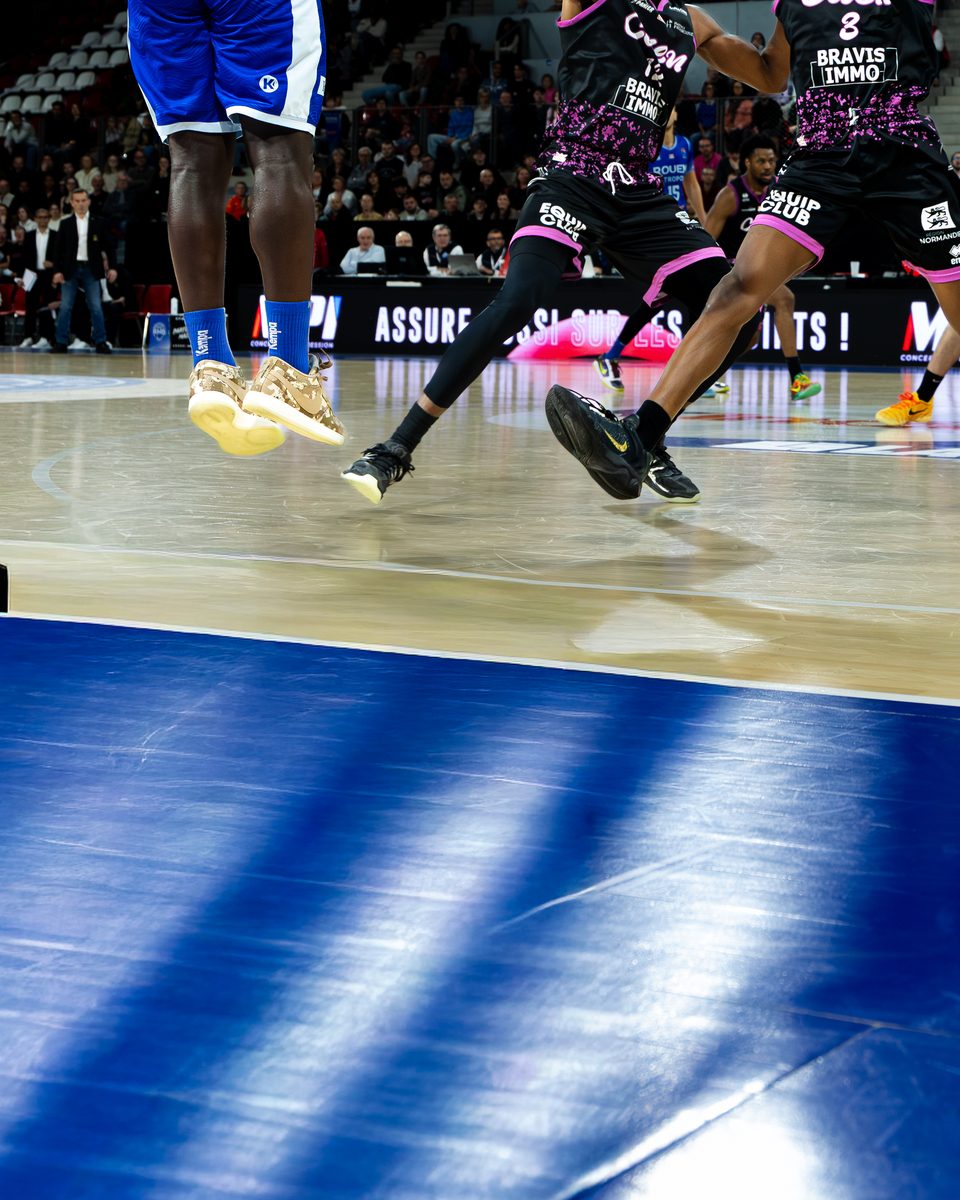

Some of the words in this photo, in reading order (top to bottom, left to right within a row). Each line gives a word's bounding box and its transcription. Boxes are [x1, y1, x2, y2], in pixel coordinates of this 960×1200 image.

[817, 47, 885, 67] BRAVIS
[825, 64, 880, 84] IMMO
[667, 185, 680, 202] 15
[758, 200, 811, 227] CLUB
[267, 322, 282, 350] Kempa
[375, 306, 472, 344] ASSURE
[196, 329, 209, 357] Kempa
